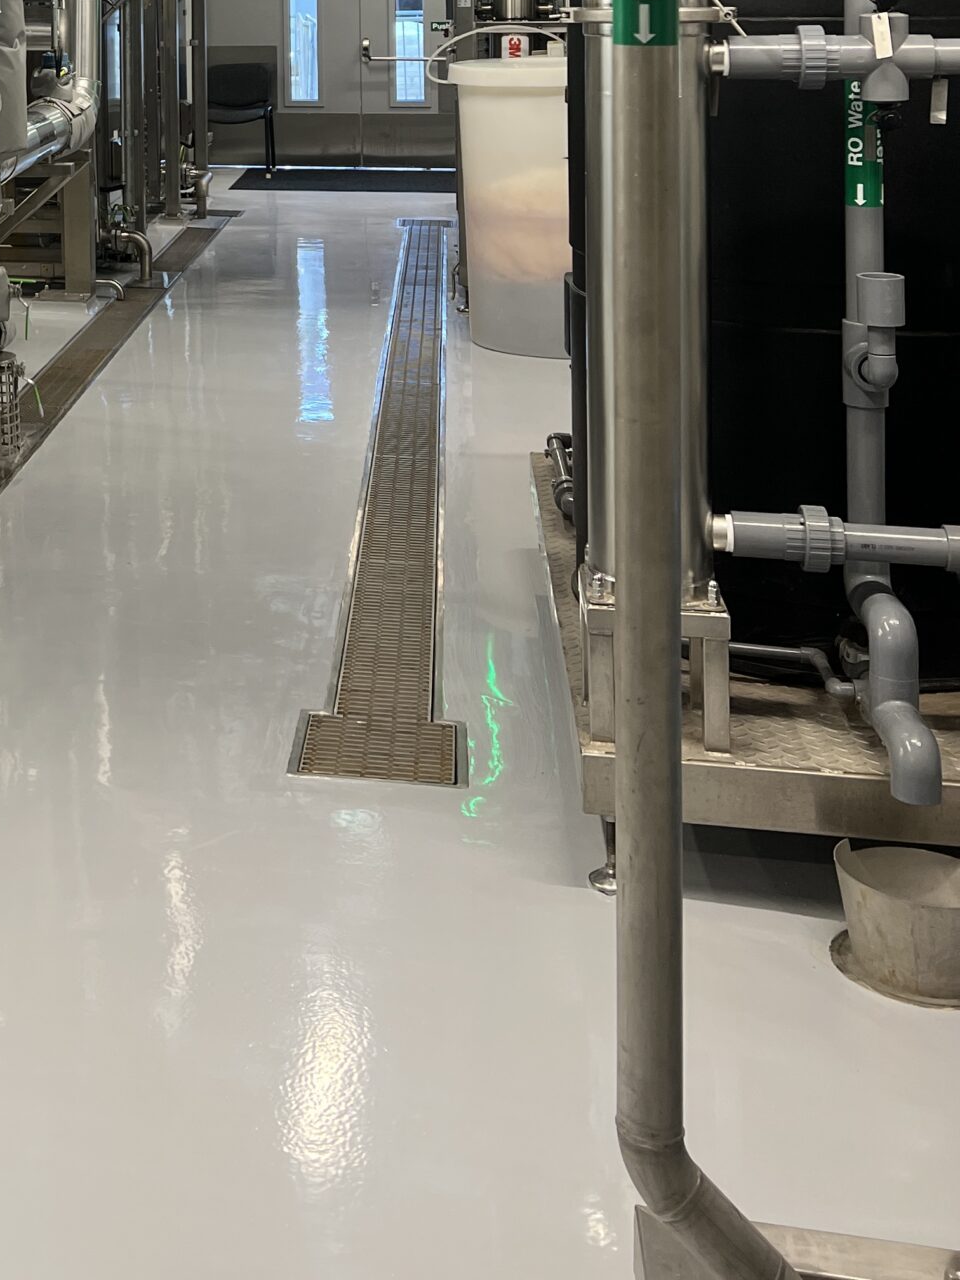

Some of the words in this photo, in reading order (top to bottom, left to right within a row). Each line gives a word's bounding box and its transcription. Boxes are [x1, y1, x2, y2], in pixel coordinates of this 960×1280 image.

[508, 37, 521, 58] 3M
[847, 81, 863, 128] Wate
[847, 137, 863, 166] RO
